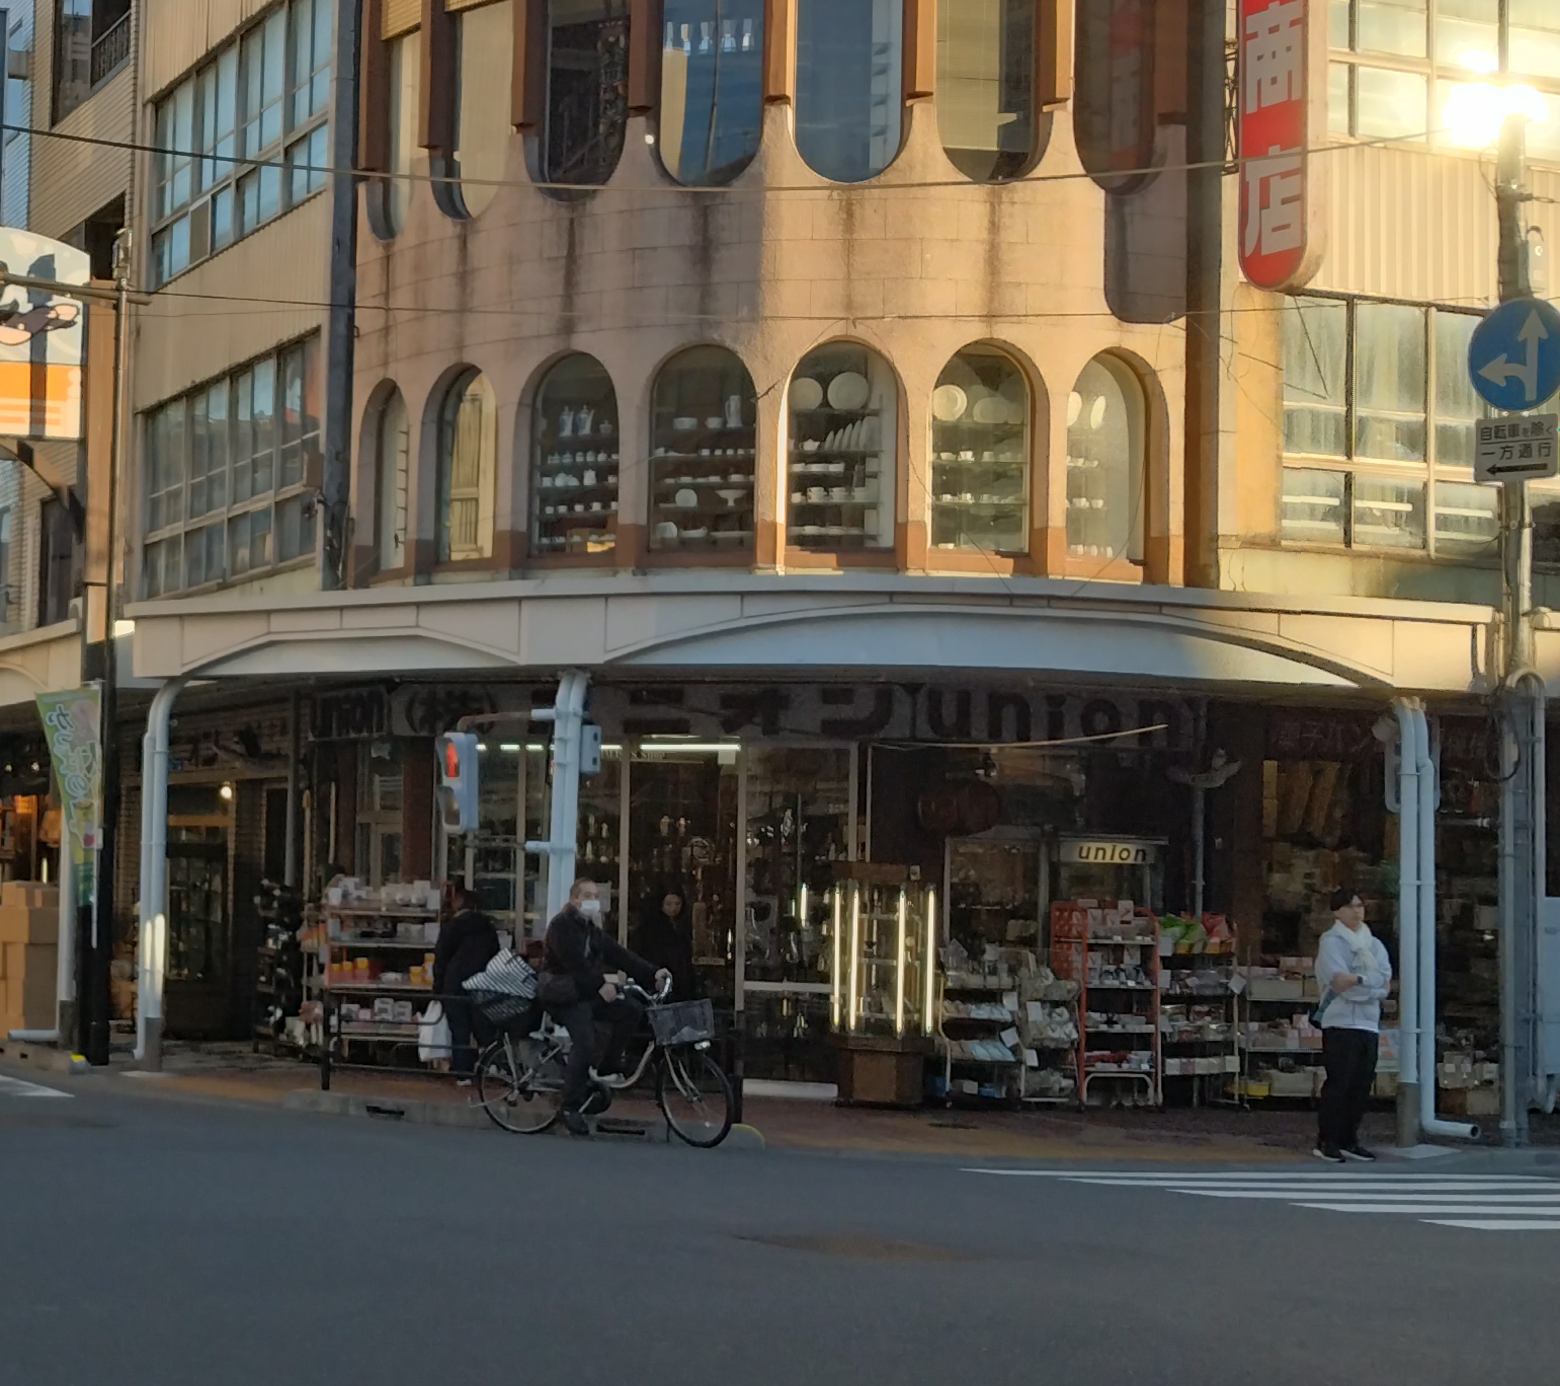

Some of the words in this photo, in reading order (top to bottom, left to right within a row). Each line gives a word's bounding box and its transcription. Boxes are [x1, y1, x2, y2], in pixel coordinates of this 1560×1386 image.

[1480, 420, 1554, 441] 自転車を除く
[1481, 441, 1552, 461] 一方通行
[928, 689, 1183, 748] union
[1078, 844, 1147, 863] union
